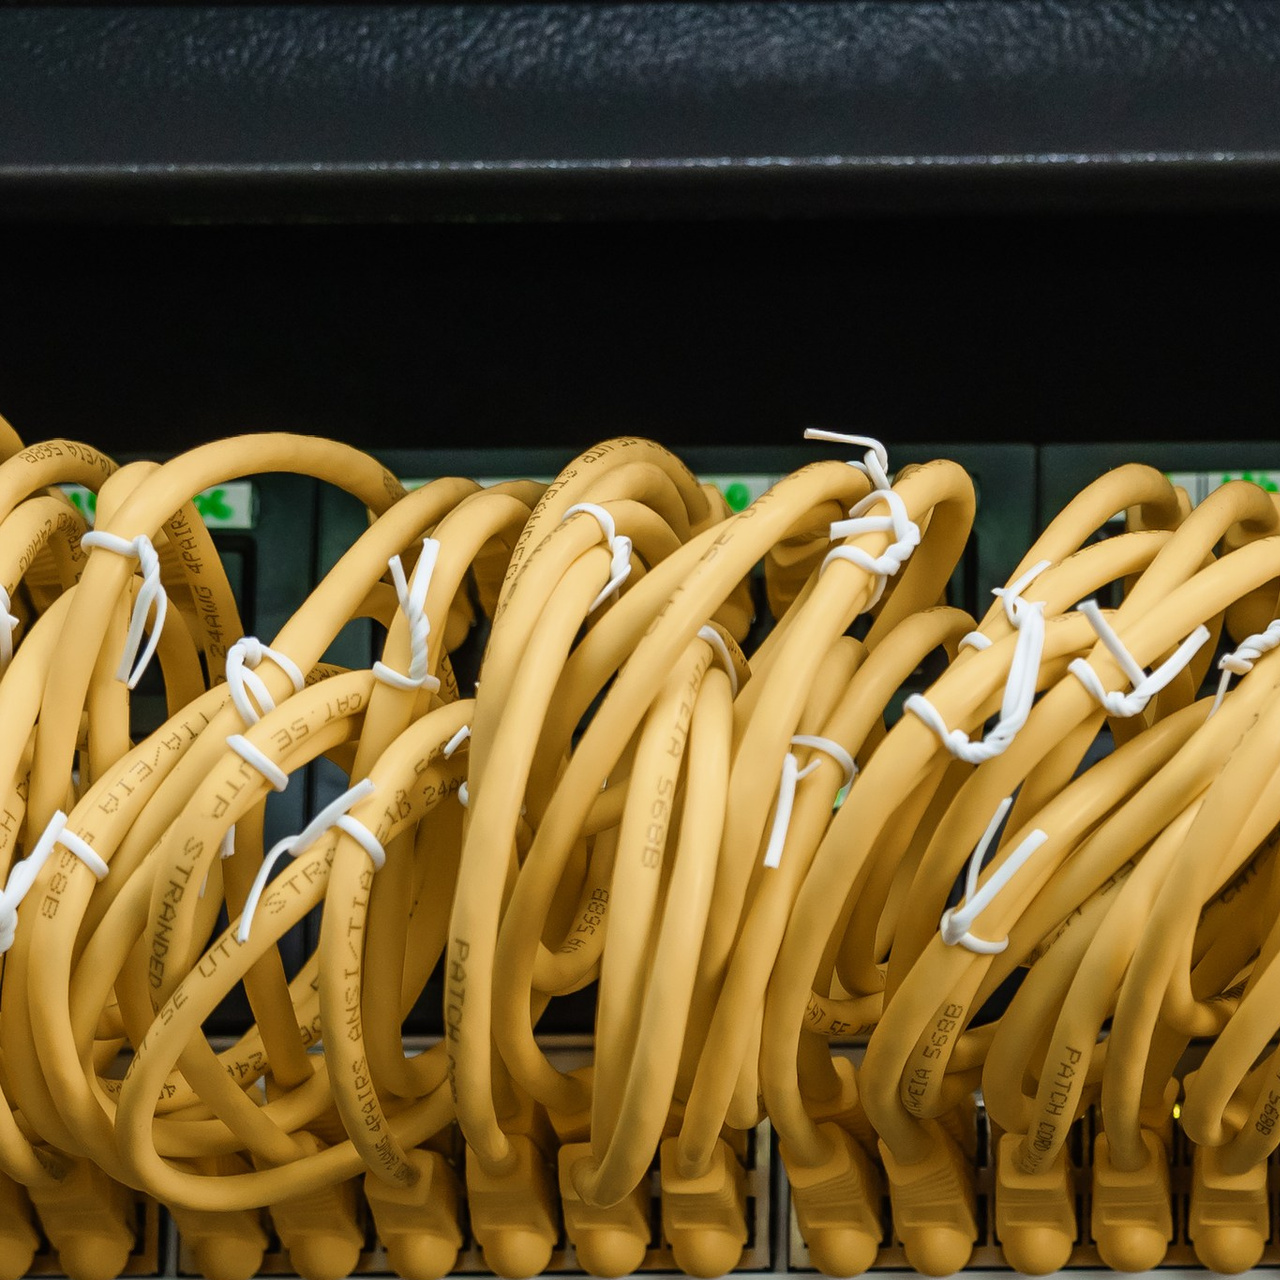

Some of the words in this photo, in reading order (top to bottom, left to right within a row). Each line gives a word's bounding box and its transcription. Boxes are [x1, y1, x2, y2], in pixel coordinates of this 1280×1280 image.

[149, 836, 204, 994] STRANDED
[447, 937, 470, 1044] PATCH
[922, 1003, 964, 1059] 568B
[1046, 1046, 1083, 1117] PATCH
